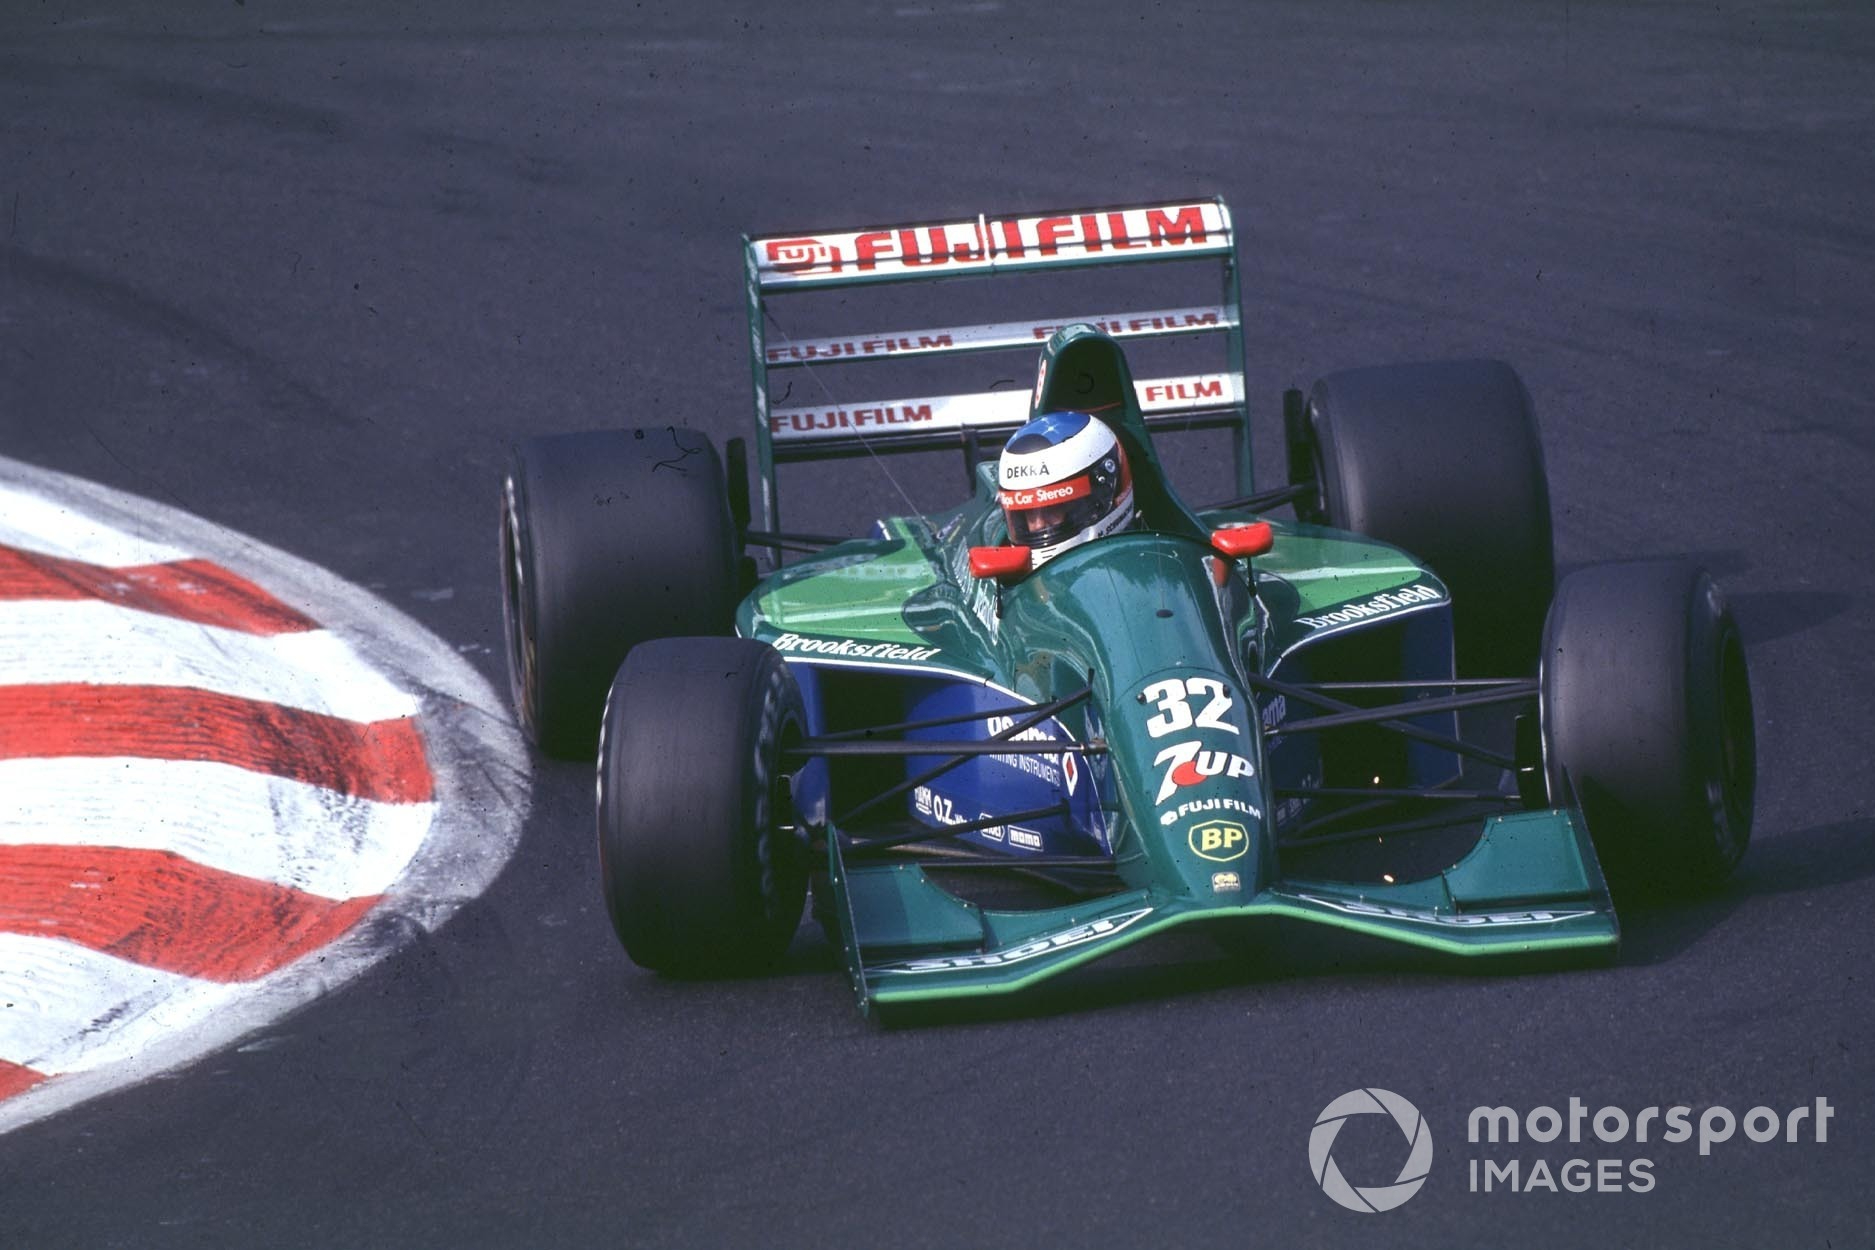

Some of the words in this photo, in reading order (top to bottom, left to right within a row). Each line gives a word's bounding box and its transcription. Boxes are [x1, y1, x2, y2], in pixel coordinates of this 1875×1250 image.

[1145, 380, 1222, 402] FILM
[1006, 463, 1050, 479] DEKRA
[1014, 491, 1034, 505] Car
[1036, 485, 1074, 502] Stereo
[1293, 583, 1443, 630] Brooksfield
[771, 633, 942, 662] Brooksfield
[1143, 676, 1240, 738] 32
[1201, 827, 1243, 851] BP
